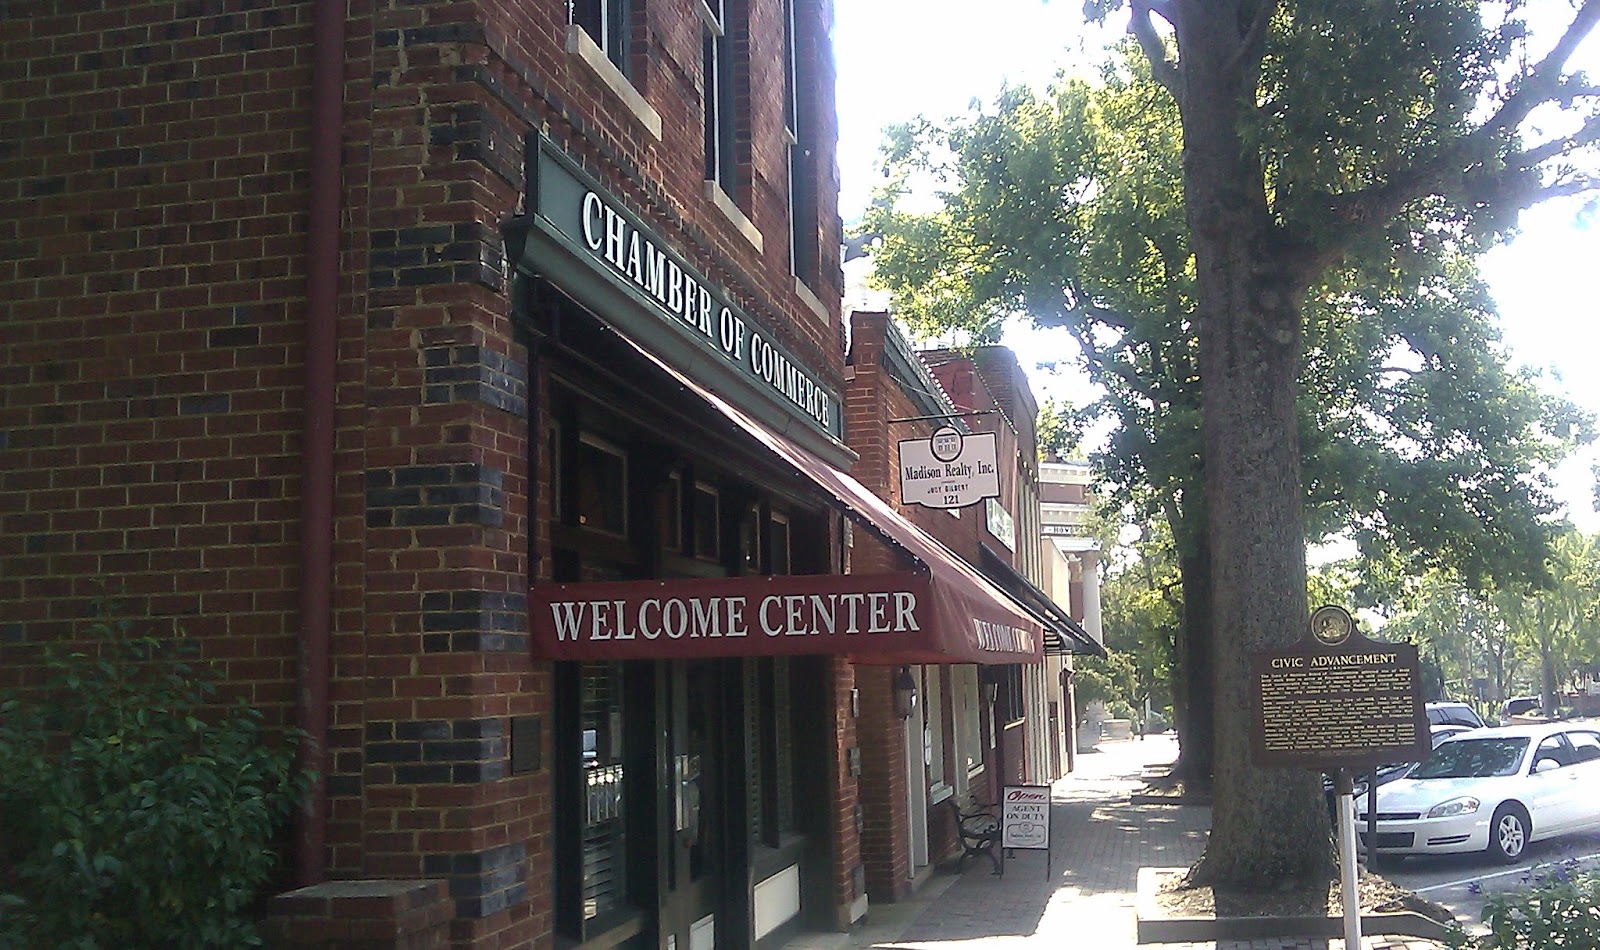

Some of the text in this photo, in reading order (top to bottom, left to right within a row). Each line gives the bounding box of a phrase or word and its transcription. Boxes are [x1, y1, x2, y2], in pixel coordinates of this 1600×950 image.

[582, 191, 831, 427] CHAMBER OF COMMERCE
[905, 461, 994, 480] Madison Realty, Inc.
[943, 495, 960, 505] 121
[550, 591, 920, 642] WELCOME CENTER
[973, 618, 1013, 651] WELCOME
[1271, 653, 1398, 668] CIVIC ADVANCEMENT
[1008, 790, 1047, 801] Open
[1006, 812, 1045, 820] ON DUTY
